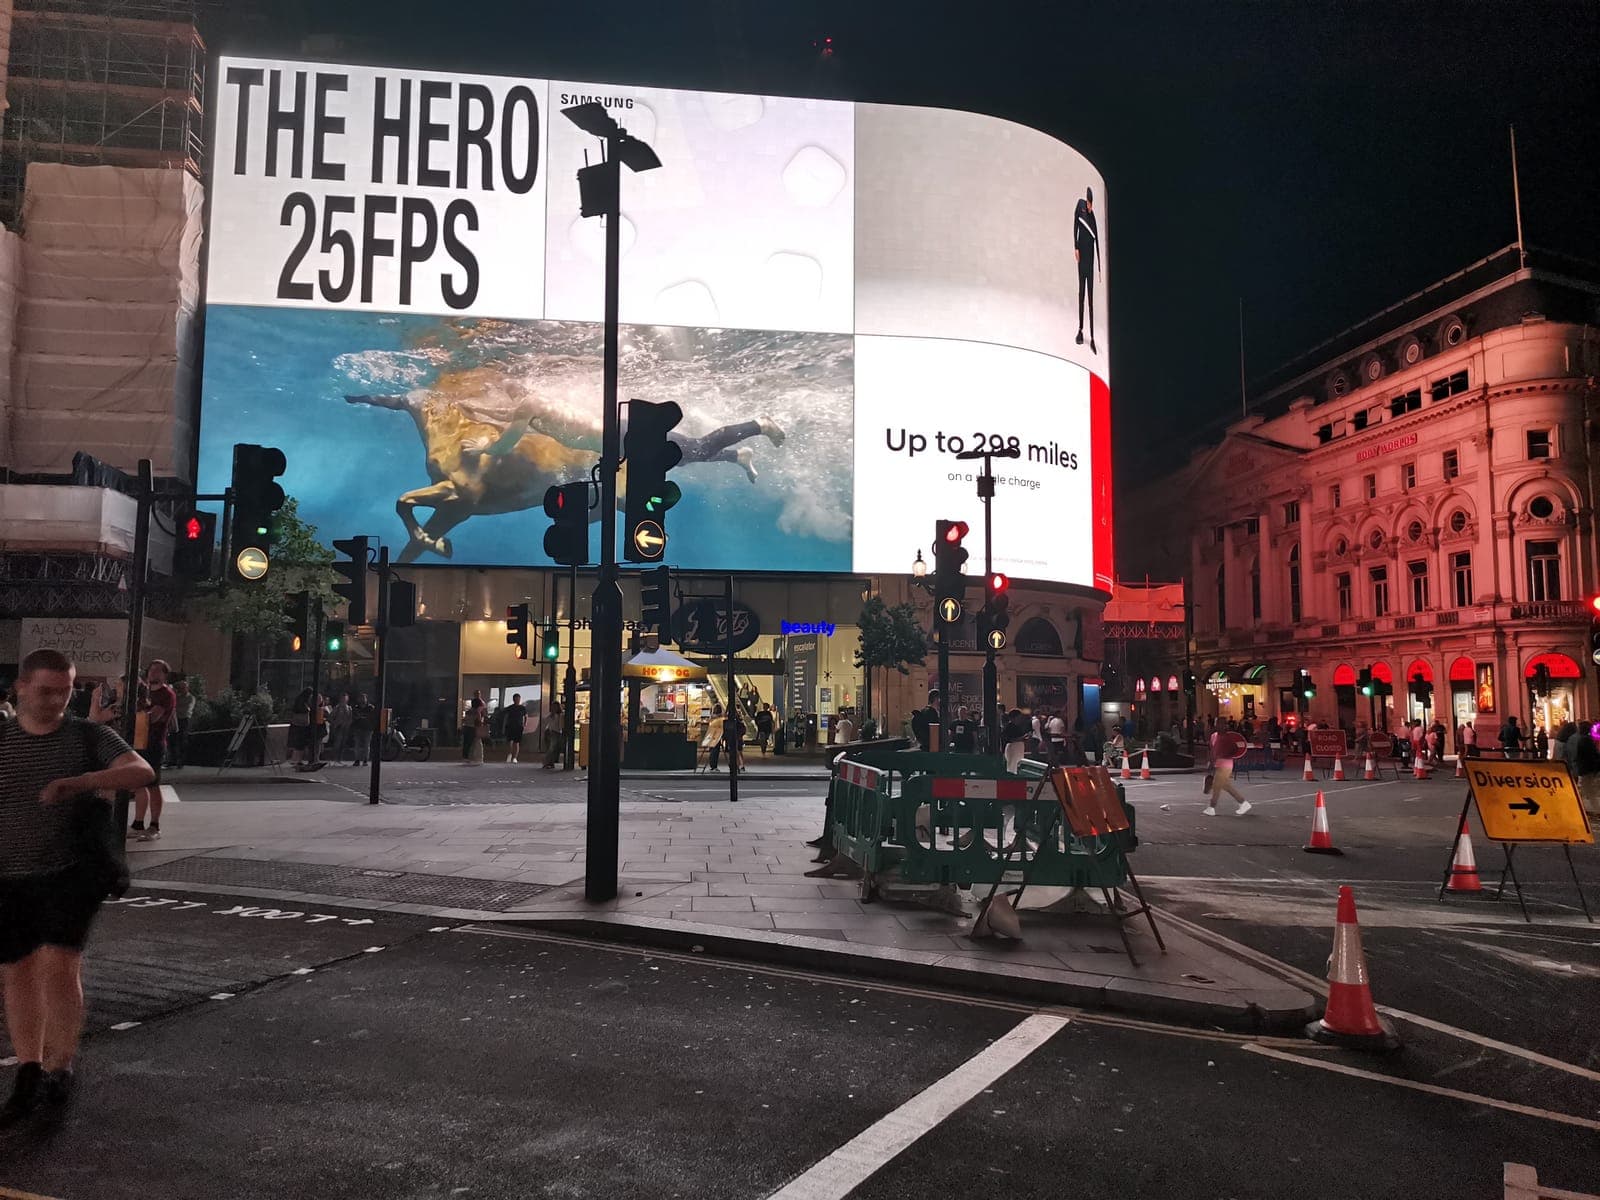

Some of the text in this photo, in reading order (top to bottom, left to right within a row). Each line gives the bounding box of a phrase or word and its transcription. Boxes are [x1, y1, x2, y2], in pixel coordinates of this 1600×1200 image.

[561, 93, 634, 109] SAMSUNG
[226, 67, 540, 194] THE HERO
[276, 191, 480, 310] 25FPS
[886, 428, 1078, 470] Up to 298 miles
[947, 472, 962, 482] on
[965, 473, 973, 482] a
[1008, 475, 1041, 491] charge
[54, 623, 97, 636] OASIS
[780, 618, 836, 637] beauty
[1473, 770, 1564, 789] Diversion
